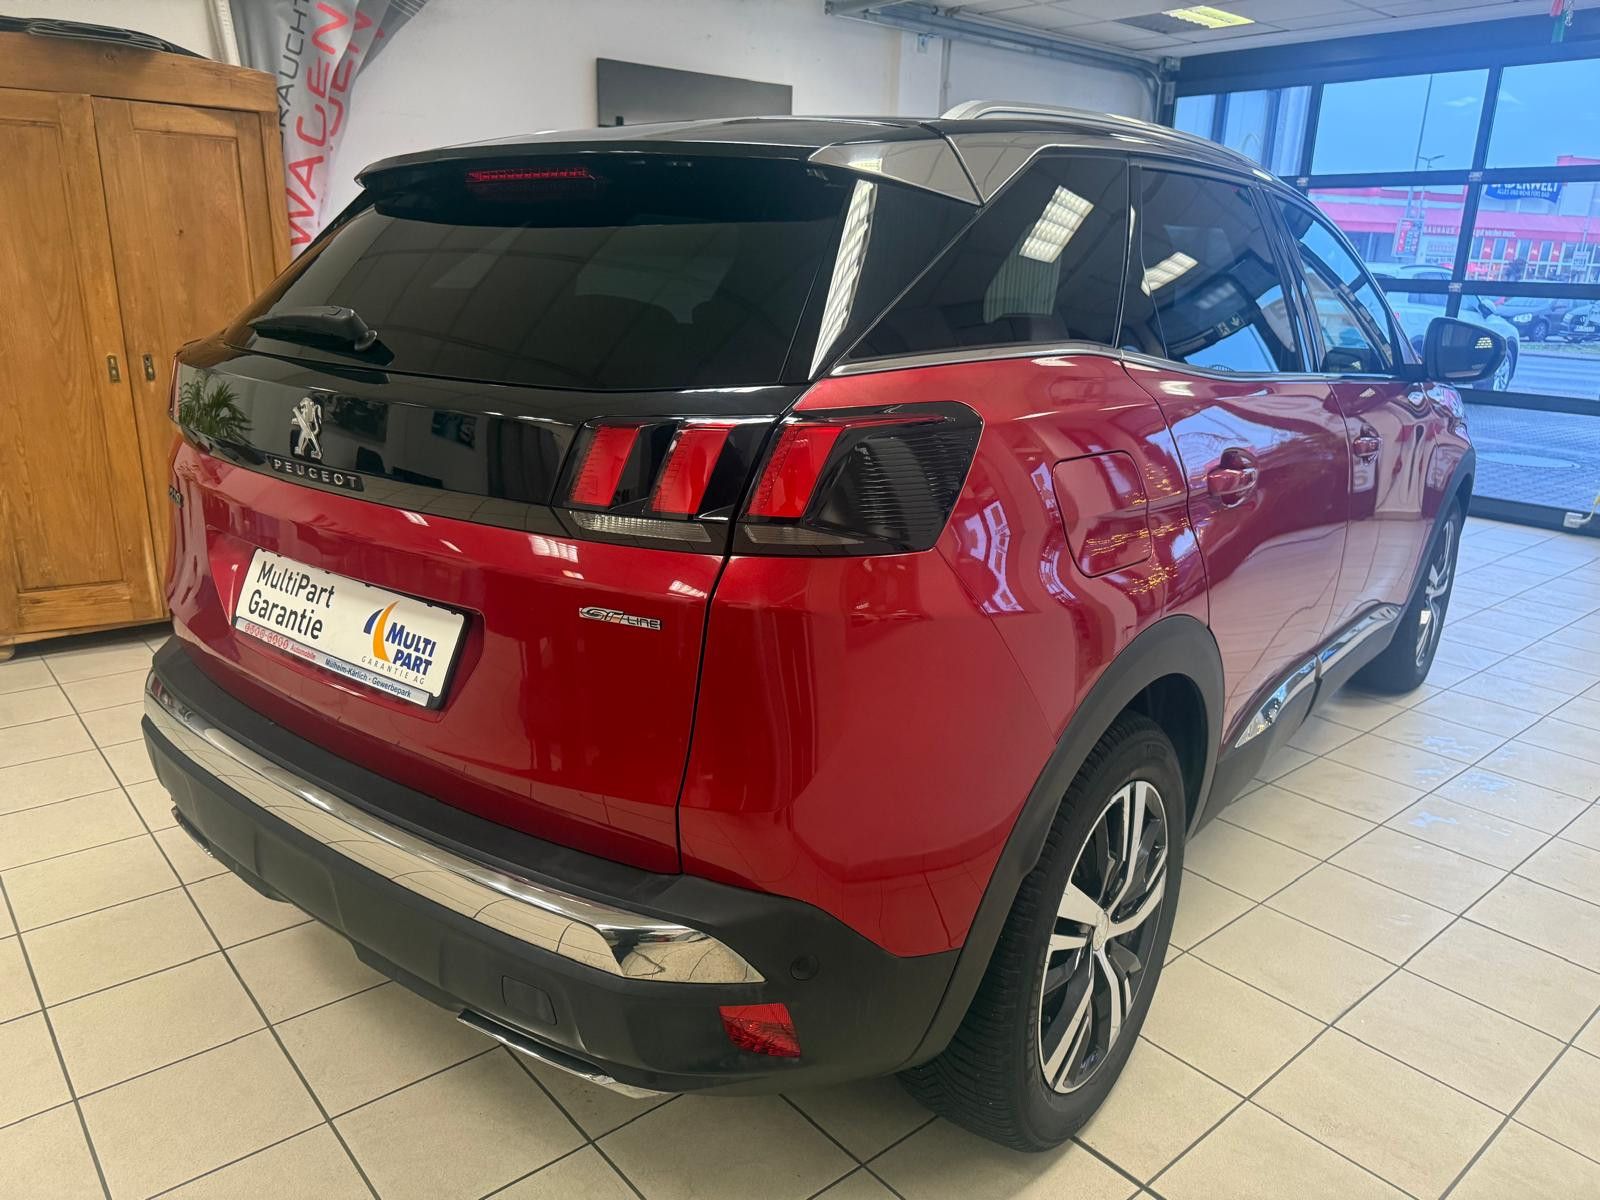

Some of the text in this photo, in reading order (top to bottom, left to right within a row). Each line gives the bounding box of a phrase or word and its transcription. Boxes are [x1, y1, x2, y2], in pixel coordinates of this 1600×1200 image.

[274, 459, 356, 488] PEUGEOT
[257, 561, 335, 608] MultiPart
[248, 589, 323, 640] Garantie
[385, 622, 437, 658] MULTI
[362, 656, 425, 685] GARANTIE AG
[393, 648, 433, 676] PART
[371, 677, 412, 698] Gewerbepark
